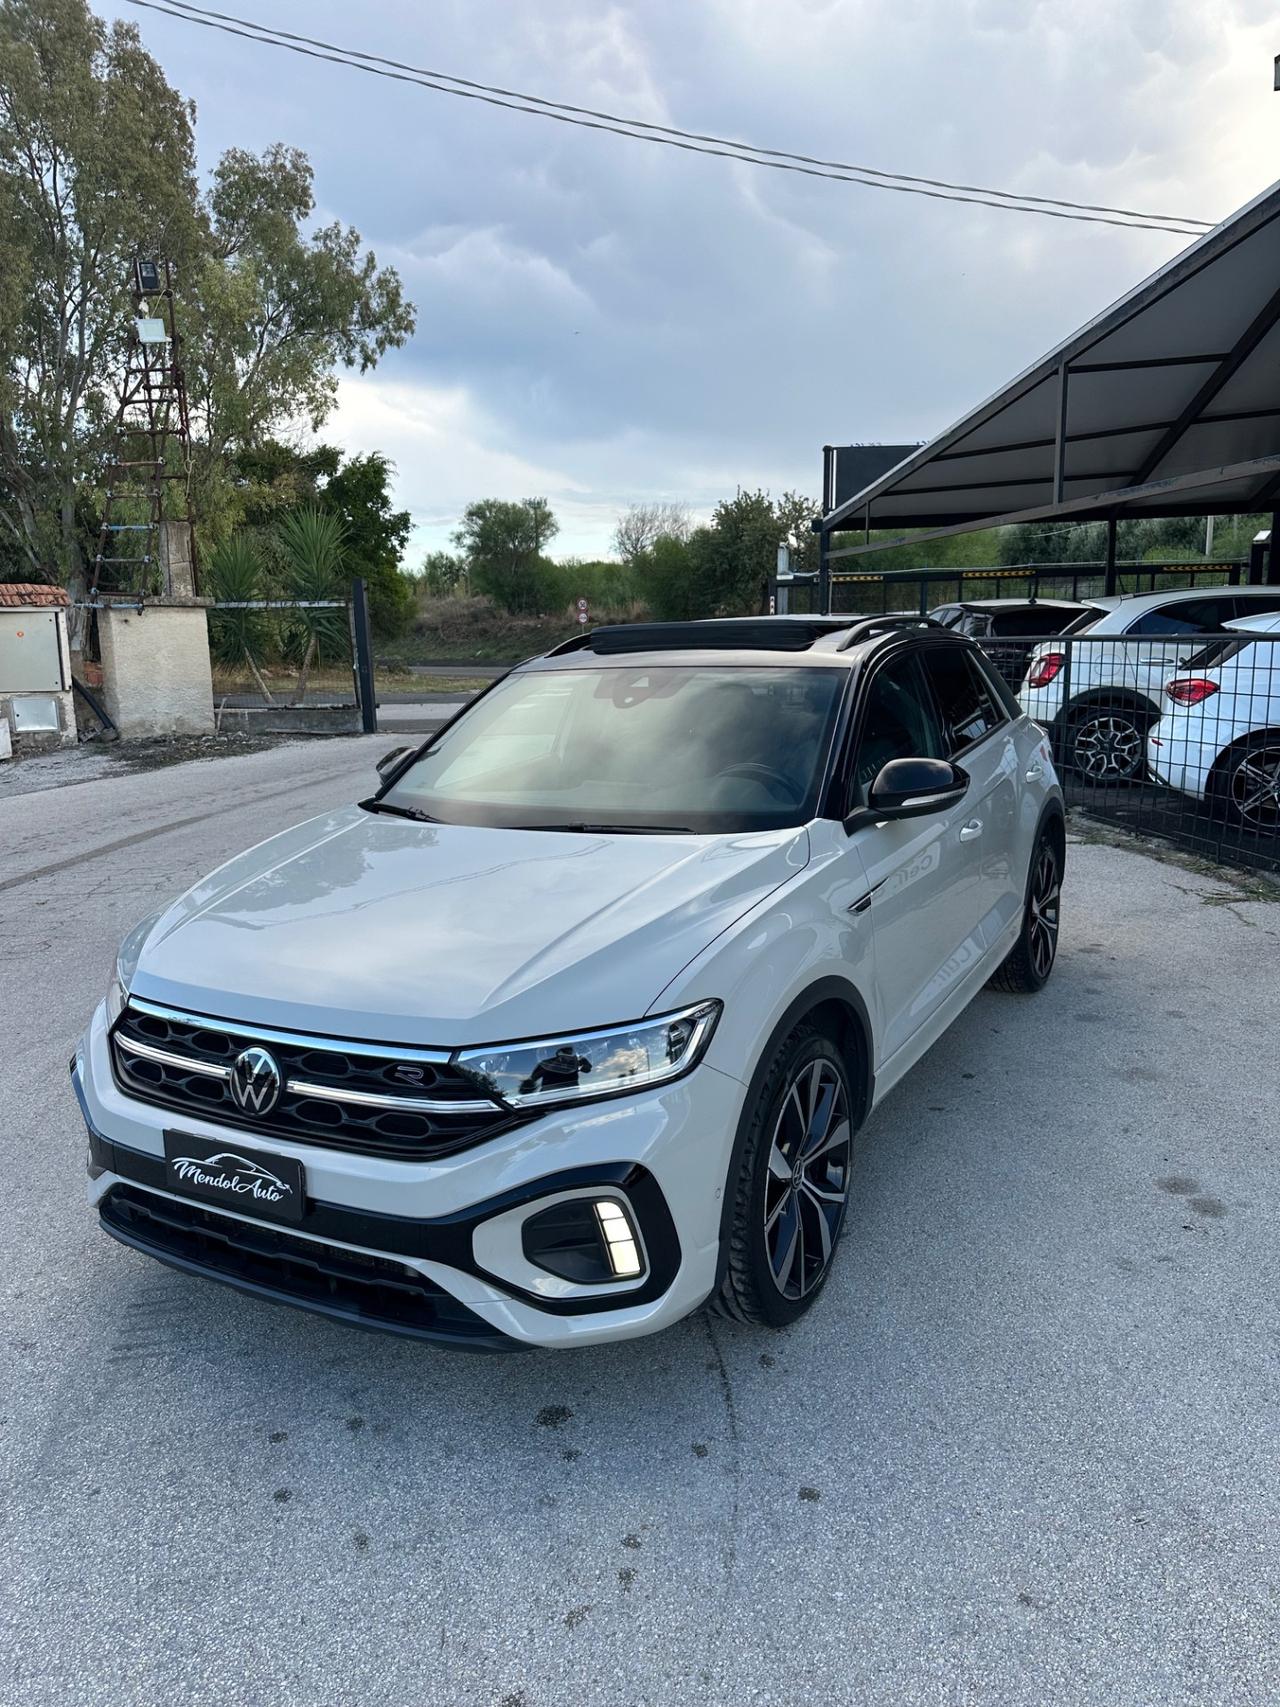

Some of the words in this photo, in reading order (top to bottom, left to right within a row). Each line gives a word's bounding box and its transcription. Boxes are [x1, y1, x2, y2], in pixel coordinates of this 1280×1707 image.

[232, 1049, 278, 1113] VW
[394, 1065, 425, 1087] R
[173, 1161, 284, 1202] MendolAuto
